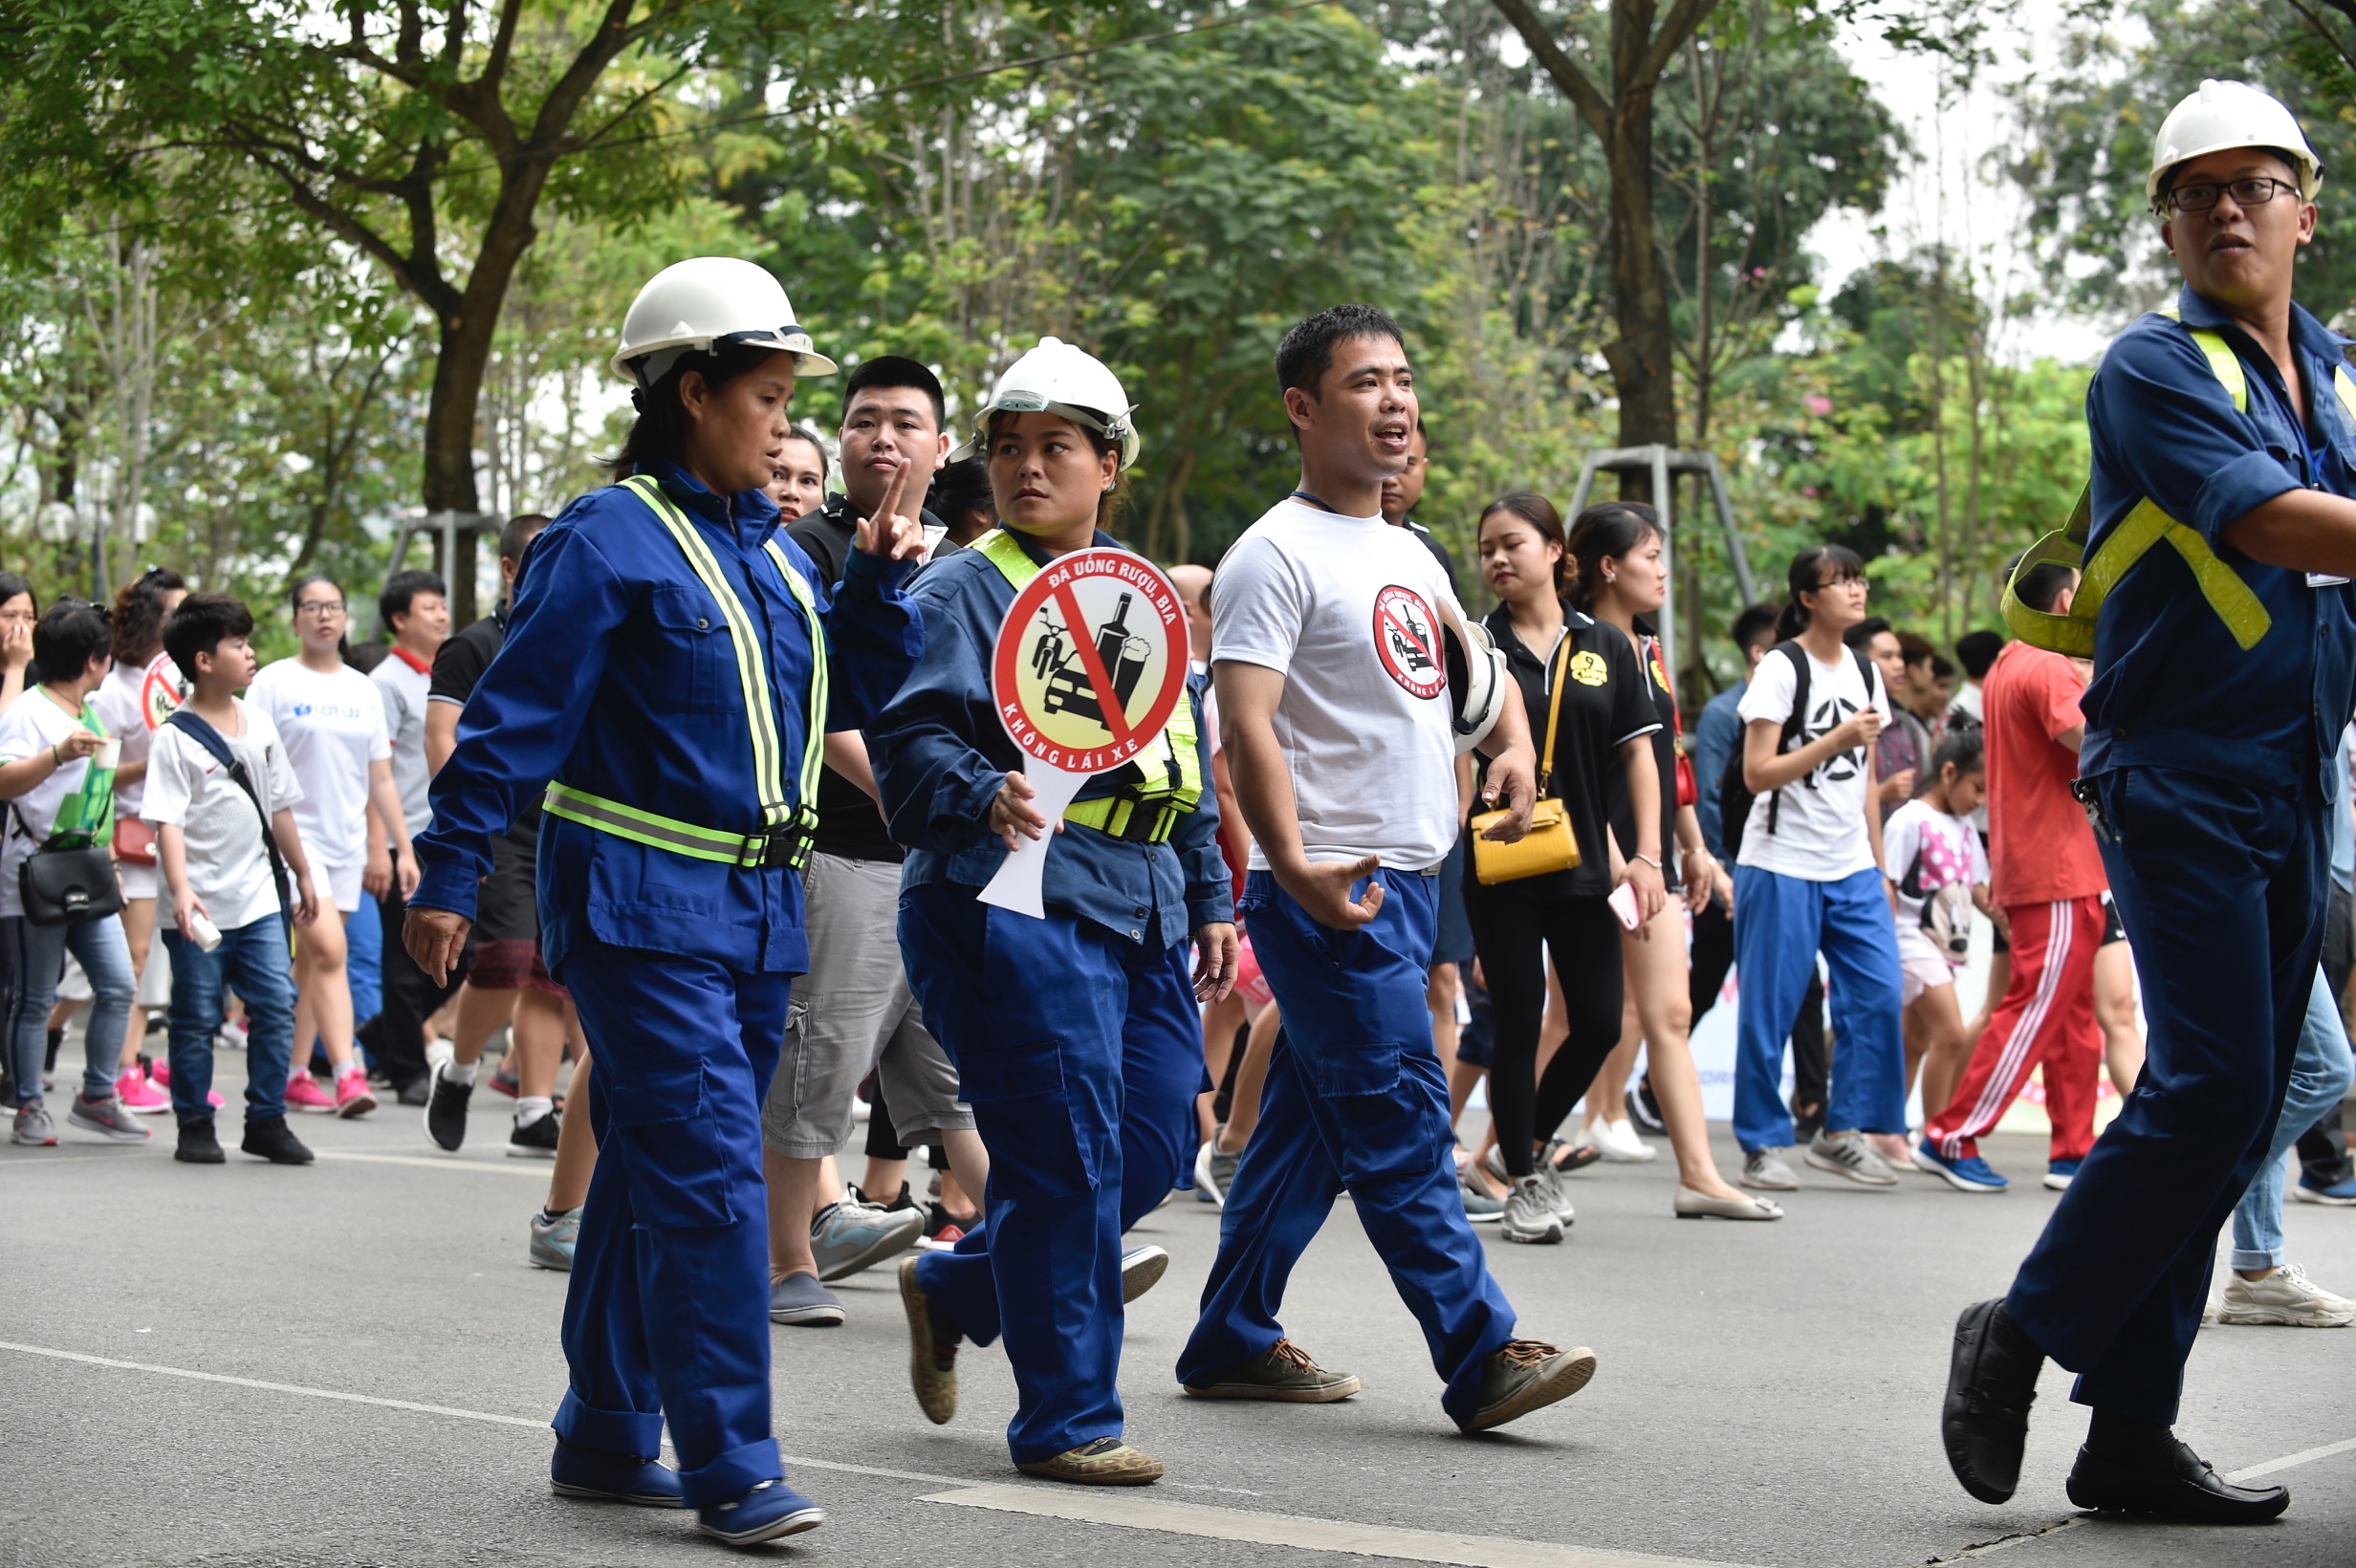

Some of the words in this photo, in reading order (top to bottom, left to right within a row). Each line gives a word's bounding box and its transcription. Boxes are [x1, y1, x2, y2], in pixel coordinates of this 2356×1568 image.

[1048, 565, 1072, 589] ĐÃ
[1073, 554, 1116, 576] UỐNG
[1118, 562, 1159, 599] RƯỢU,
[1155, 594, 1177, 625] BIA
[1585, 656, 1594, 669] 9
[1003, 703, 1059, 764] KHÔNG
[1067, 751, 1103, 769] LÁI
[1111, 738, 1139, 761] XE
